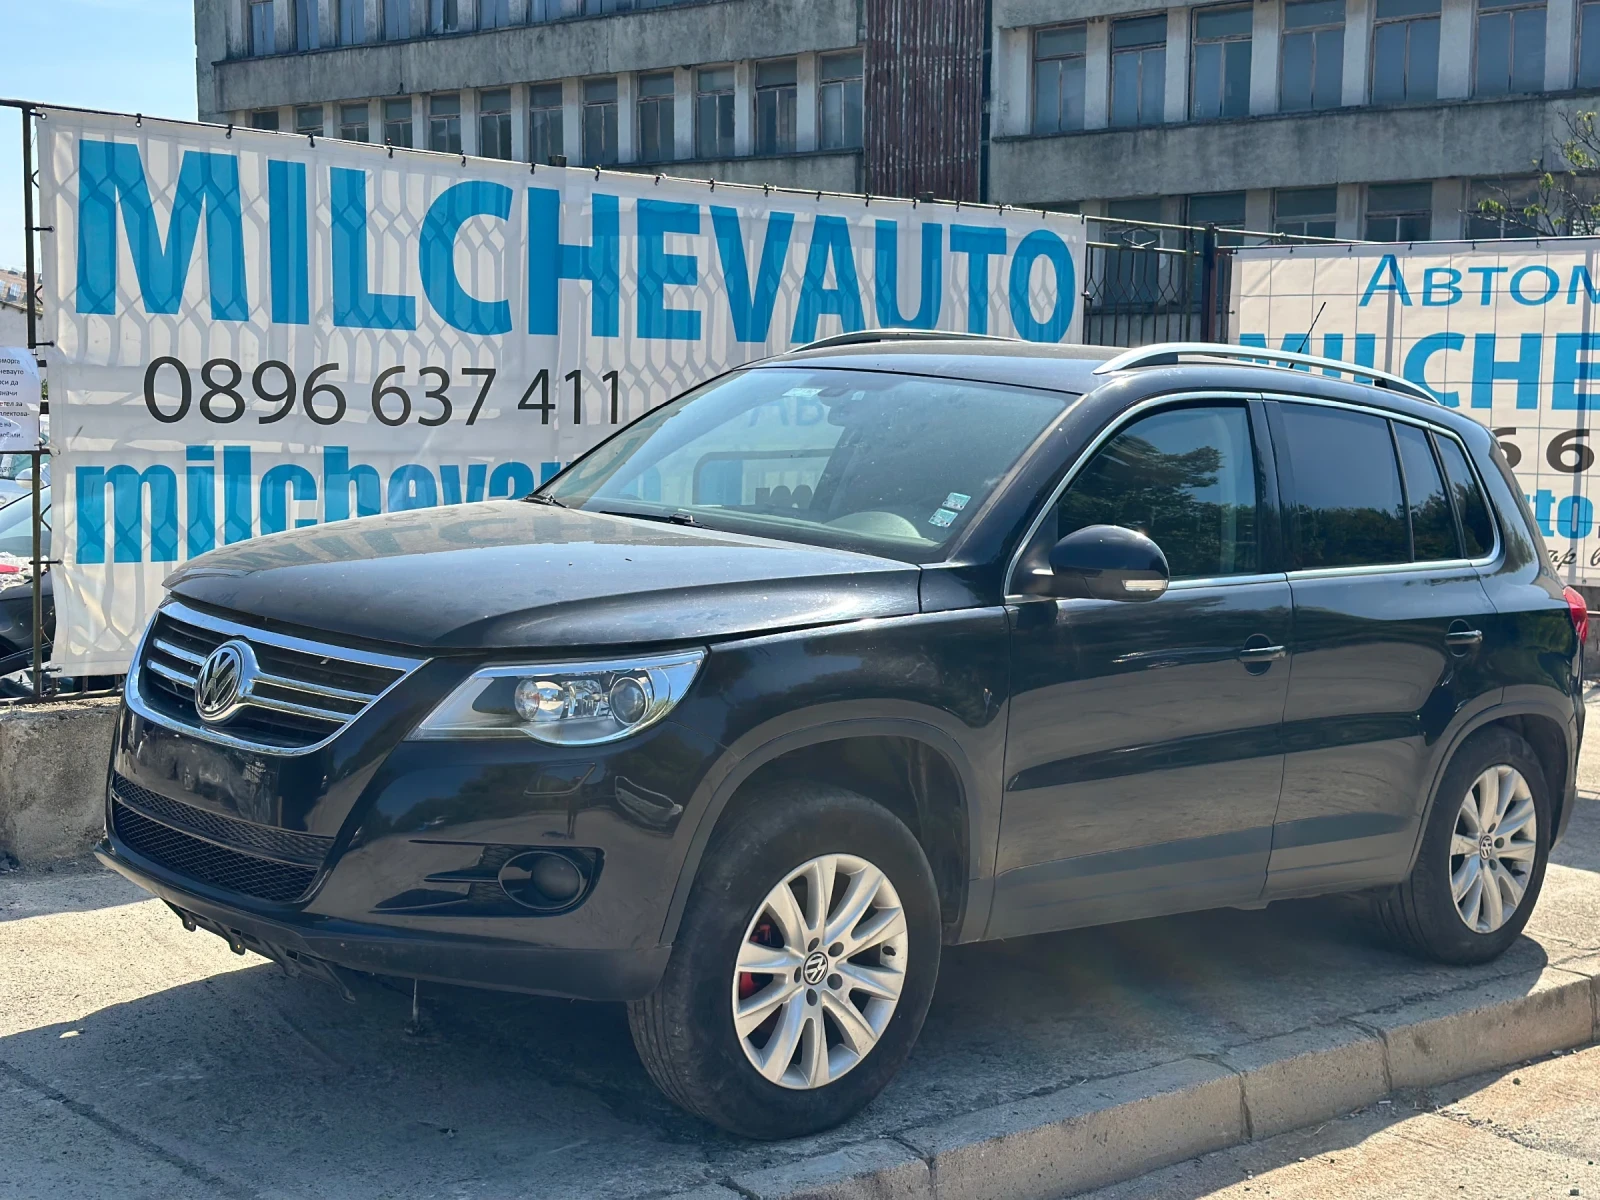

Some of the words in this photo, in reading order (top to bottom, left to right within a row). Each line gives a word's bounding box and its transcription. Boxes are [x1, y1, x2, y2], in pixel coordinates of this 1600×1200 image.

[76, 139, 1076, 344] MILCHEVAUTO
[143, 356, 348, 426] 0896
[371, 365, 497, 427] 637
[517, 369, 620, 425] 411
